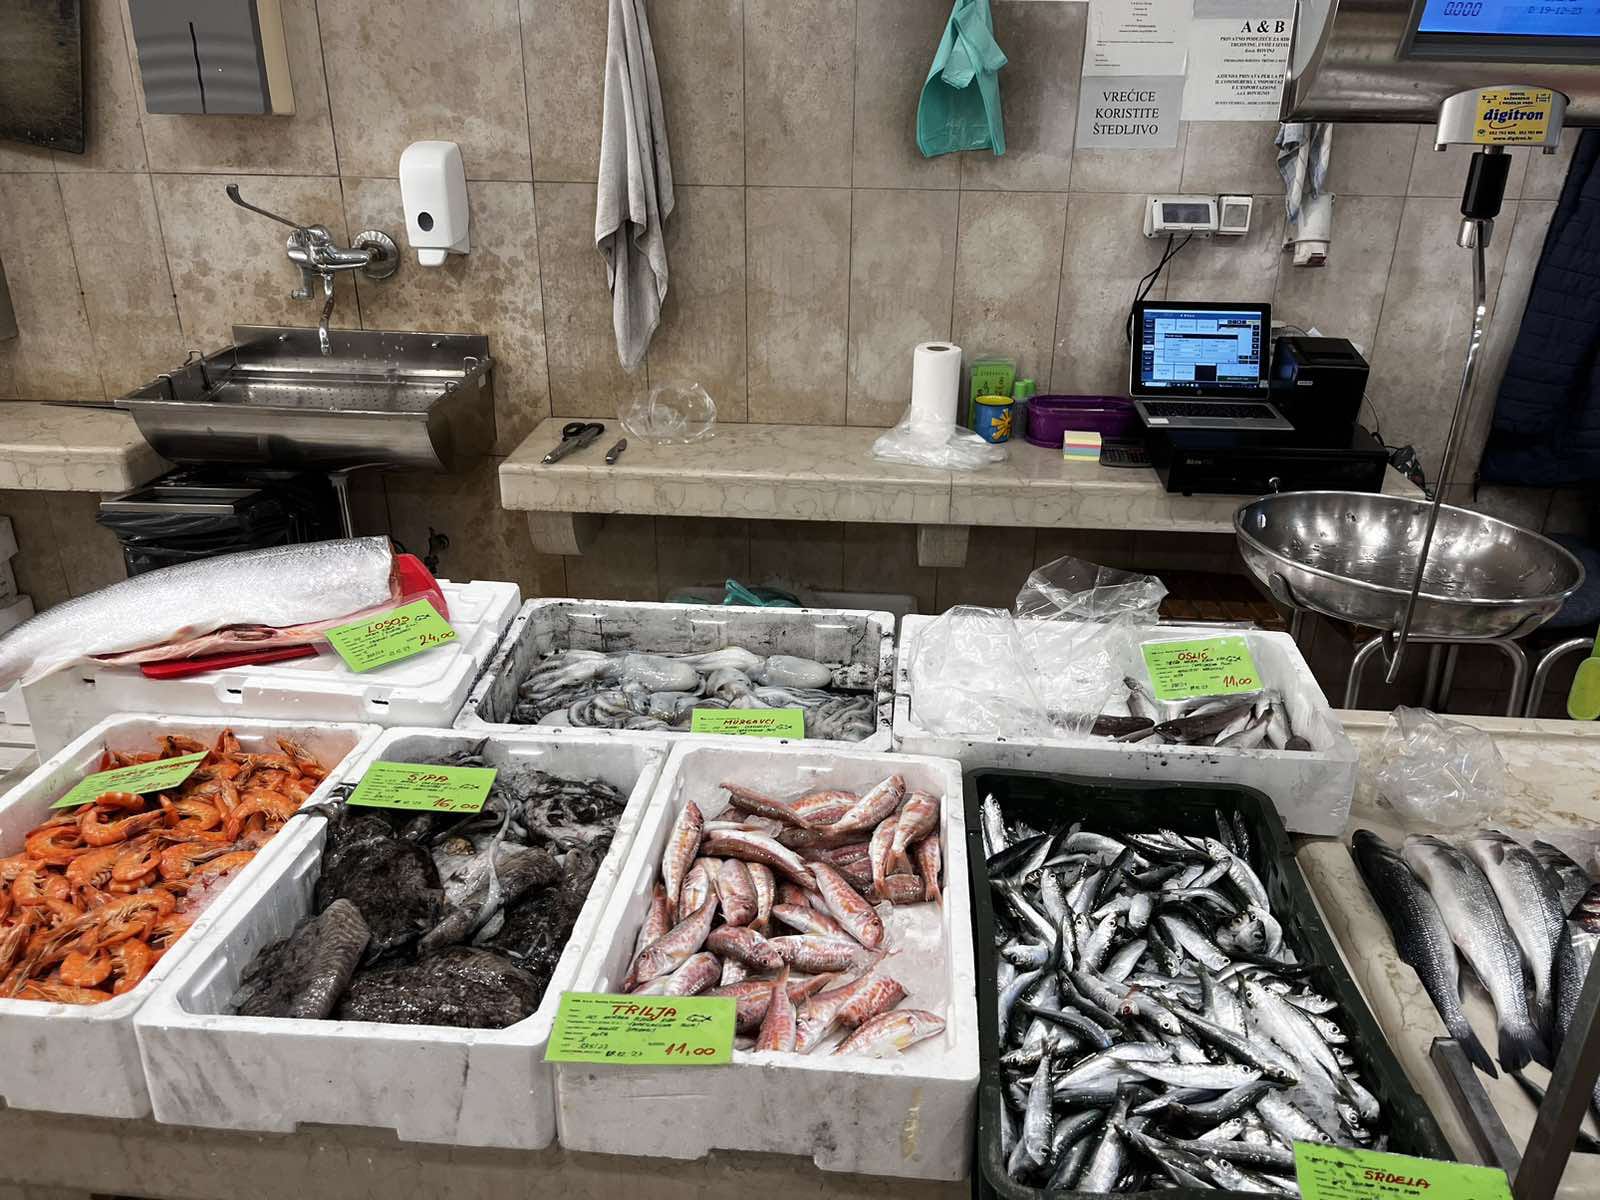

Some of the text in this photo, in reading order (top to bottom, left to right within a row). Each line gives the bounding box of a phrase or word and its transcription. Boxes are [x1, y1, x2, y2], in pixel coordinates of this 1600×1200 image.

[1241, 20, 1285, 33] A & B
[1103, 88, 1156, 102] VREĆICE
[1095, 108, 1159, 119] KORISTITE
[1483, 109, 1544, 123] digitron
[1093, 122, 1158, 135] ŠTEDLJIVO
[419, 631, 455, 646] 24,00
[1223, 675, 1252, 688] 11,00
[407, 774, 449, 783] SIPA
[433, 798, 480, 810] 16,00
[612, 1004, 677, 1021] TRILJA
[665, 1043, 716, 1057] 11,00
